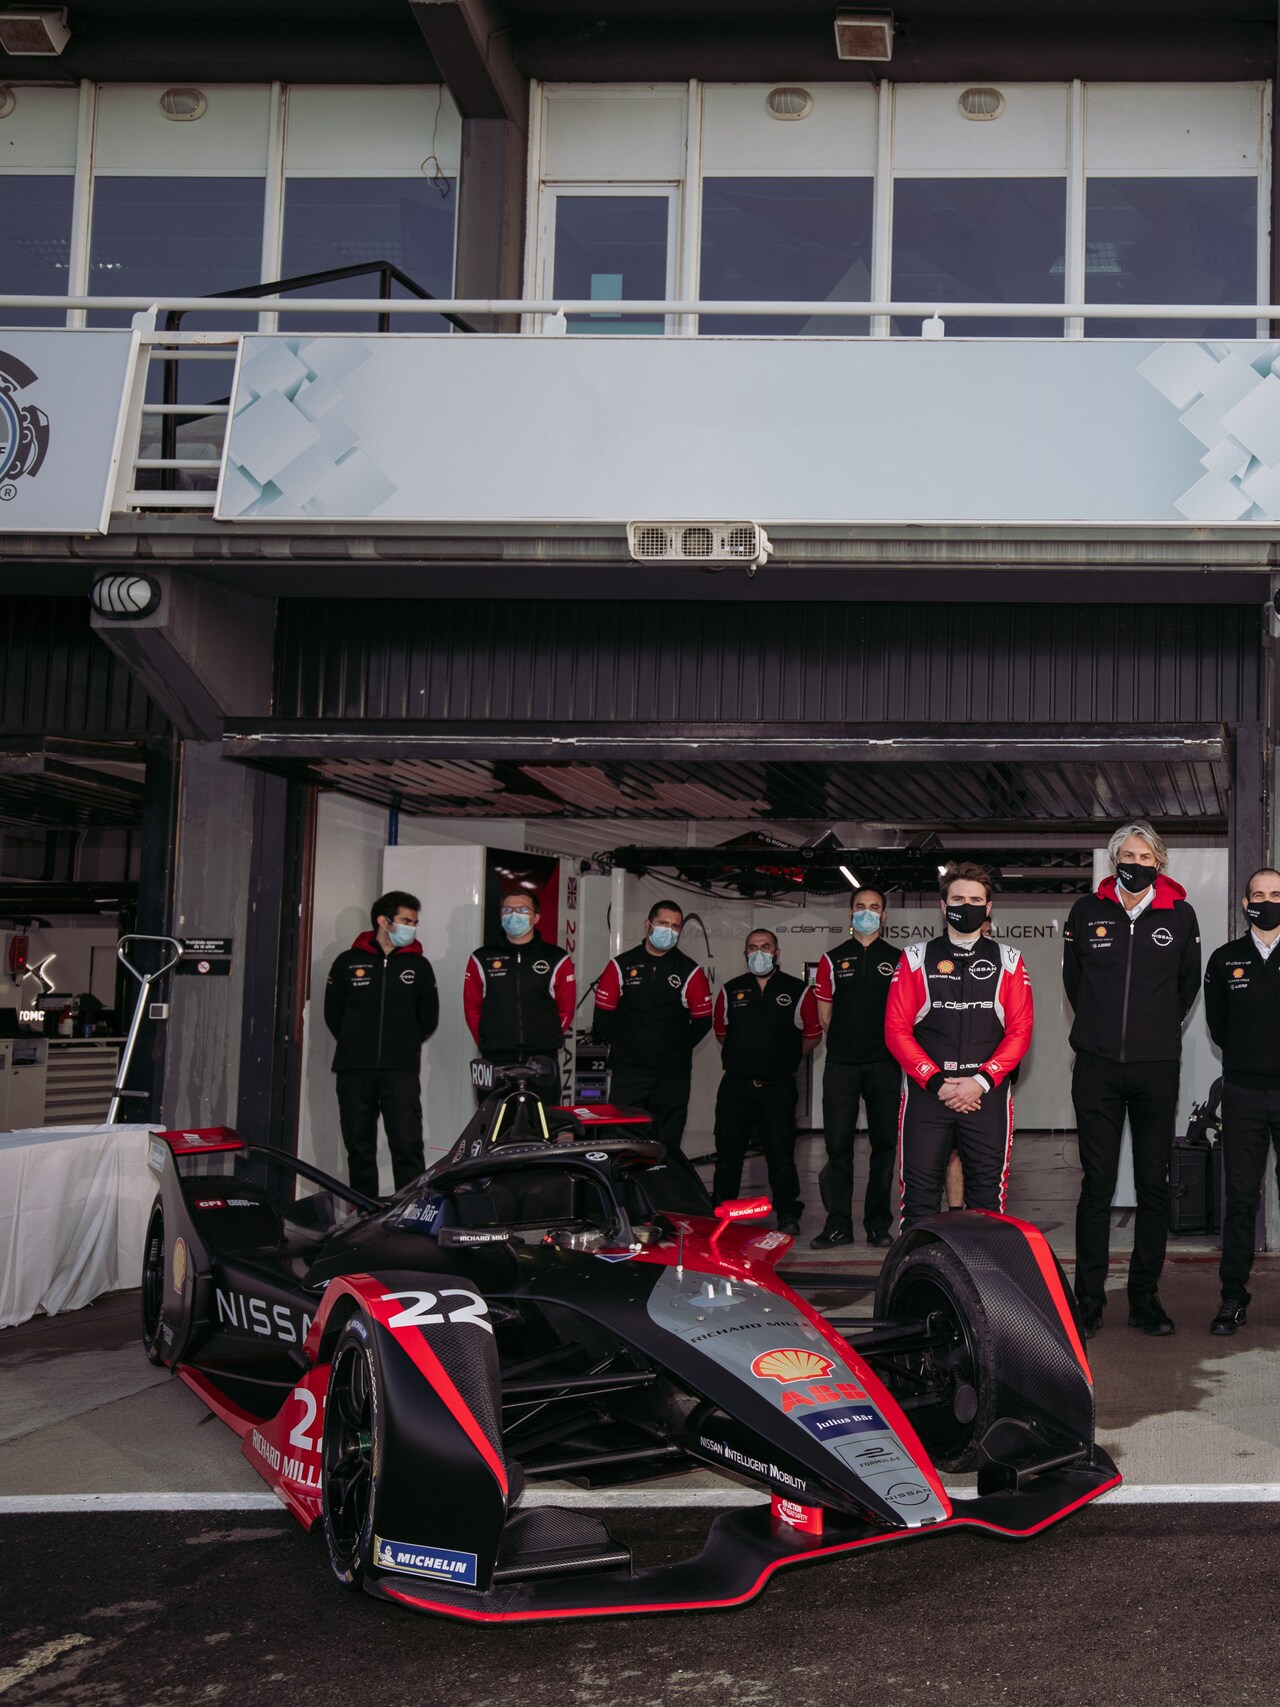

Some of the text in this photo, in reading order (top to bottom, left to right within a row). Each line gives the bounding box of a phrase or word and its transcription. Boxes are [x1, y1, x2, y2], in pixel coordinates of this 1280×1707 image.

[989, 924, 1057, 939] LLIGENT
[933, 1001, 993, 1010] e.dams
[472, 1064, 492, 1086] ROW
[592, 1061, 605, 1069] 22
[420, 1205, 438, 1222] Bär
[216, 1288, 313, 1344] NISS
[381, 1288, 493, 1335] 22
[690, 1323, 761, 1343] RICHARD
[781, 1383, 868, 1413] ABB
[289, 1388, 326, 1453] 2
[815, 1413, 875, 1431] Julius Bär
[252, 1428, 281, 1471] RICHARD
[700, 1437, 723, 1454] NISSAN
[724, 1441, 768, 1474] INTELLIGENT
[884, 1486, 931, 1502] NISSAN
[397, 1552, 467, 1574] MICHELIN
